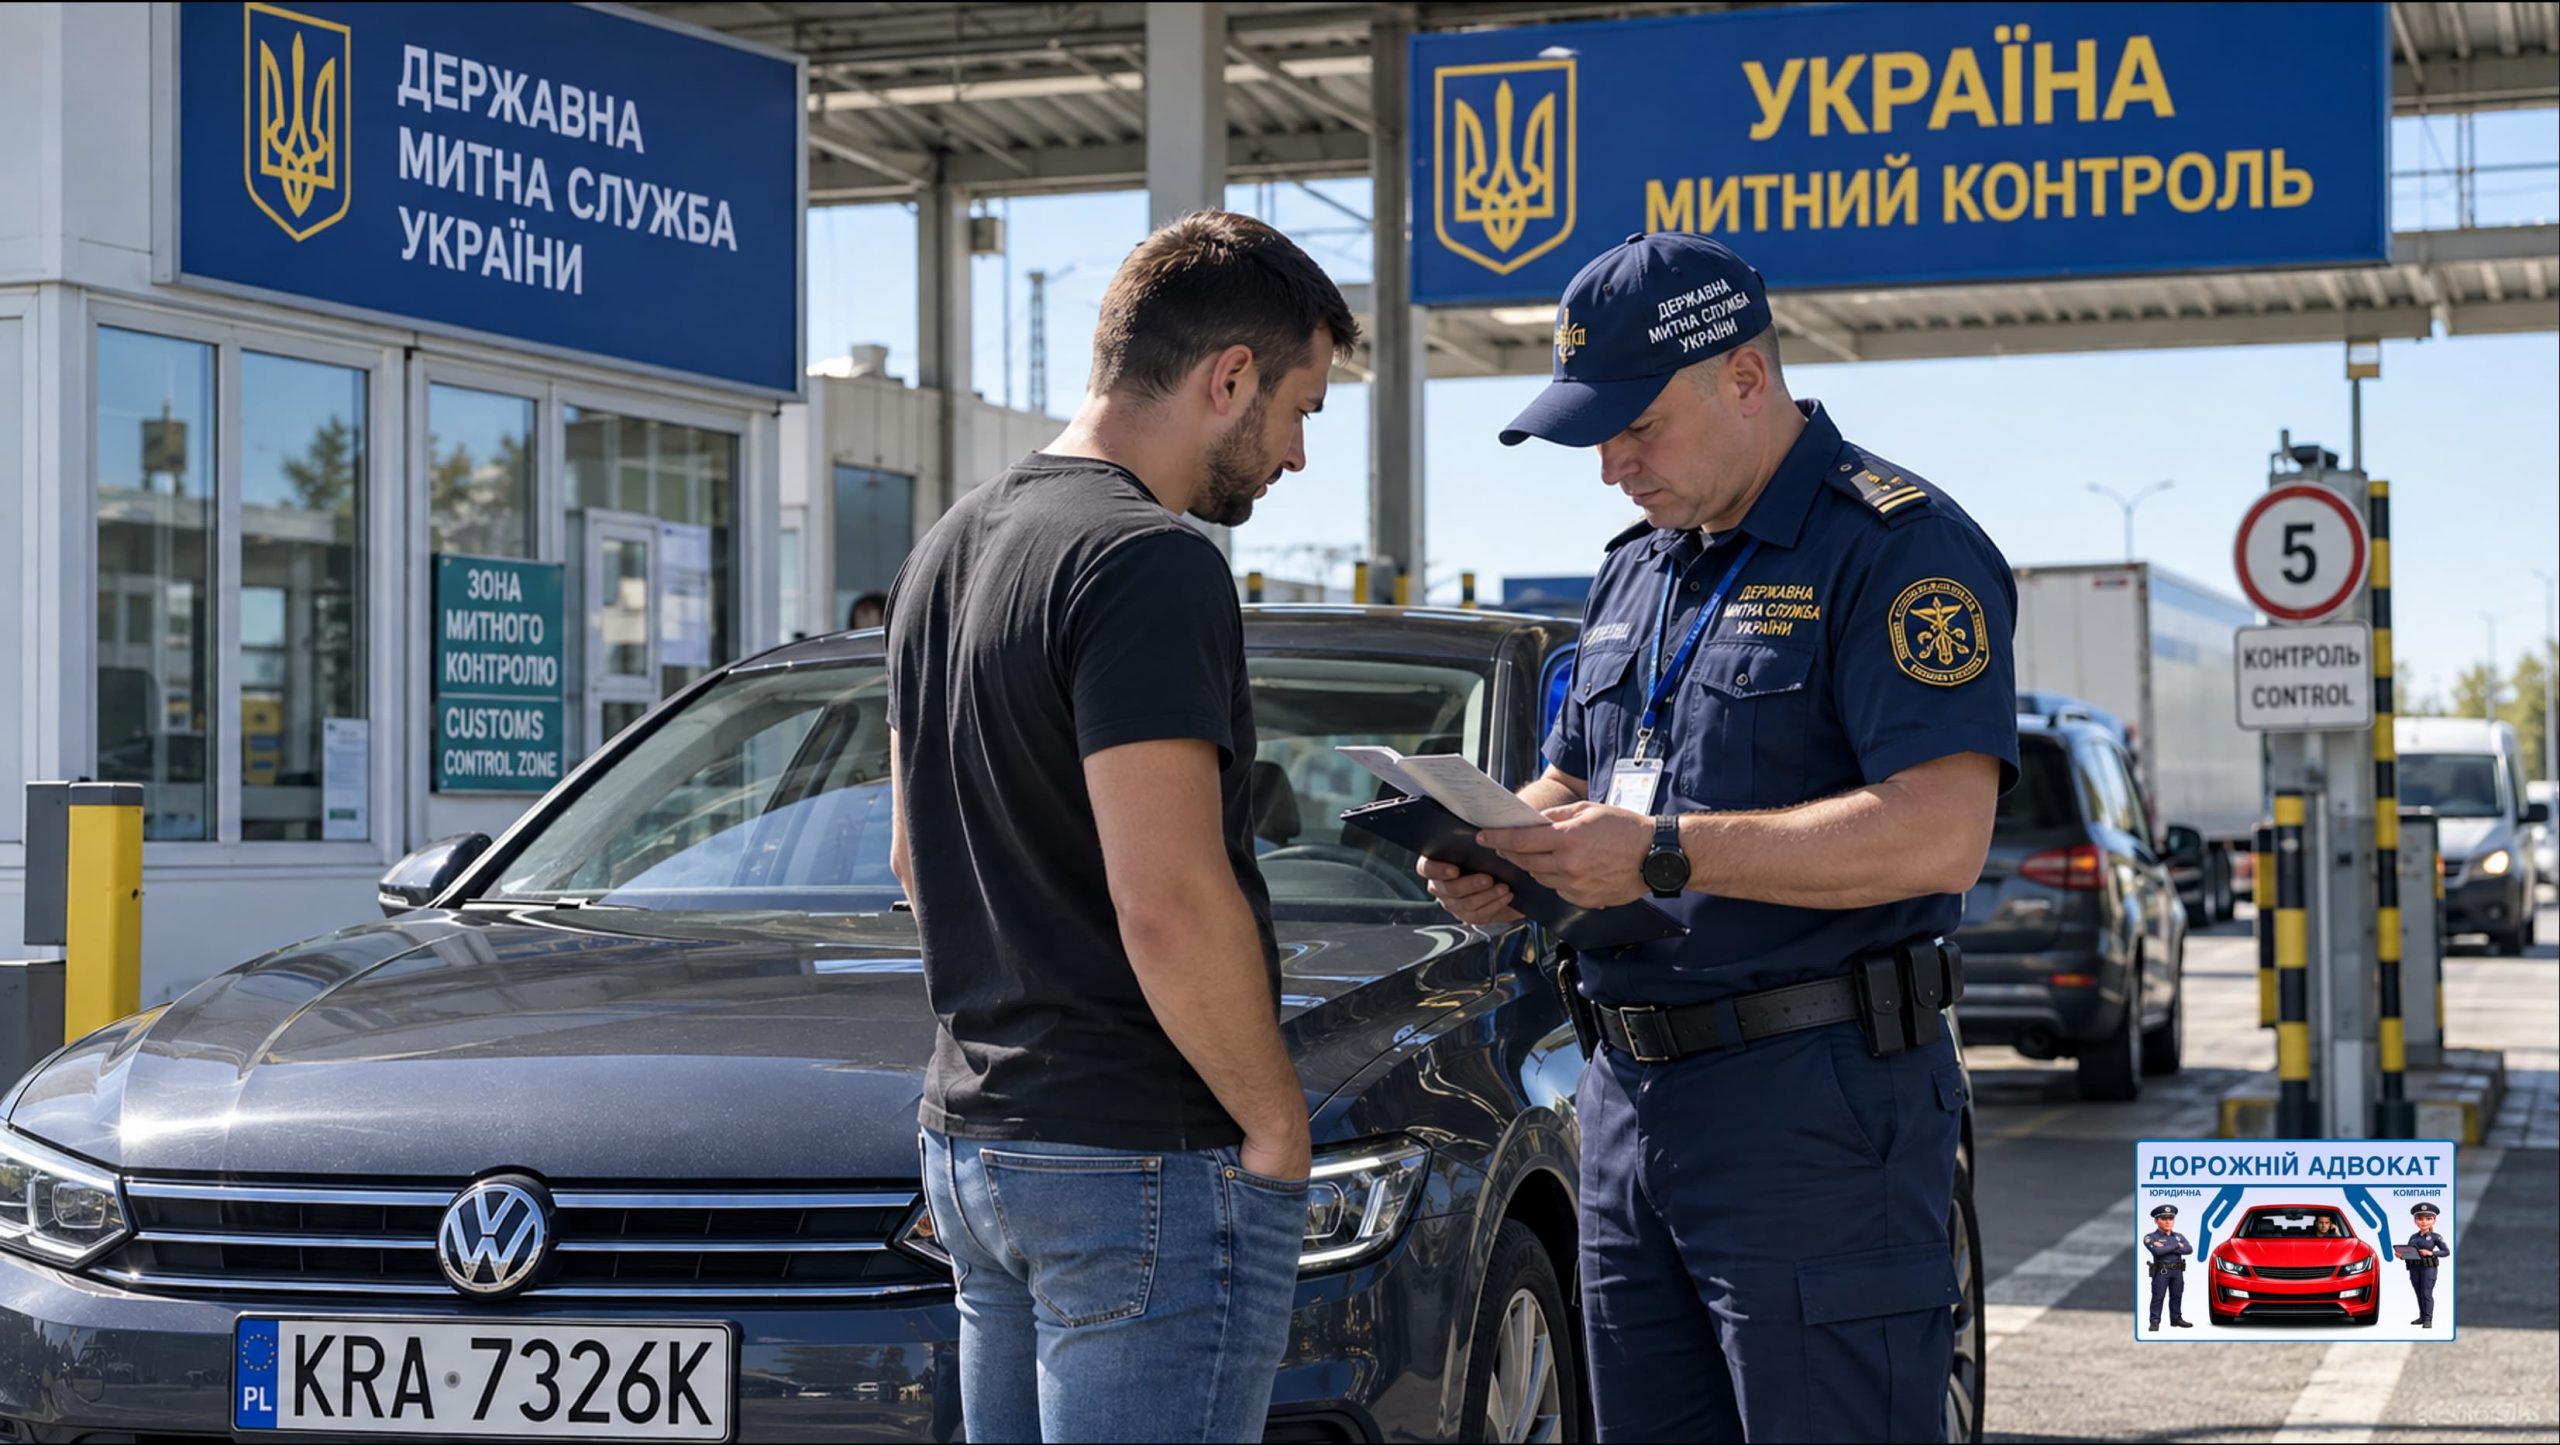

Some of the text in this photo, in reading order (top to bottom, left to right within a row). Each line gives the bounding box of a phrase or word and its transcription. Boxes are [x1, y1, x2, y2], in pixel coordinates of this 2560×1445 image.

[398, 44, 644, 154] ДЕРЖАВНА
[1742, 23, 2176, 141] УКРАЇНА
[400, 127, 738, 251] МИТНА СЛУЖБА
[1645, 148, 2314, 234] МИТНИЙ КОНТРОЛЬ
[398, 206, 583, 295] УКРАЇНИ
[1658, 278, 1732, 322] ДЕРЖАВНА
[1648, 314, 1700, 344] МИТНА
[2281, 522, 2316, 584] 5
[467, 569, 522, 602] ЗОНА
[446, 609, 544, 645] МИТНОГО
[445, 652, 557, 687] КОНТРОЛЮ
[2244, 644, 2360, 670] КОНТРОЛЬ
[2252, 684, 2354, 709] CONTROL
[445, 707, 544, 741] CUSTOMS
[445, 750, 557, 777] CONTROL ZONE
[294, 1334, 713, 1425] KRA 7326K
[243, 1386, 272, 1412] PL
